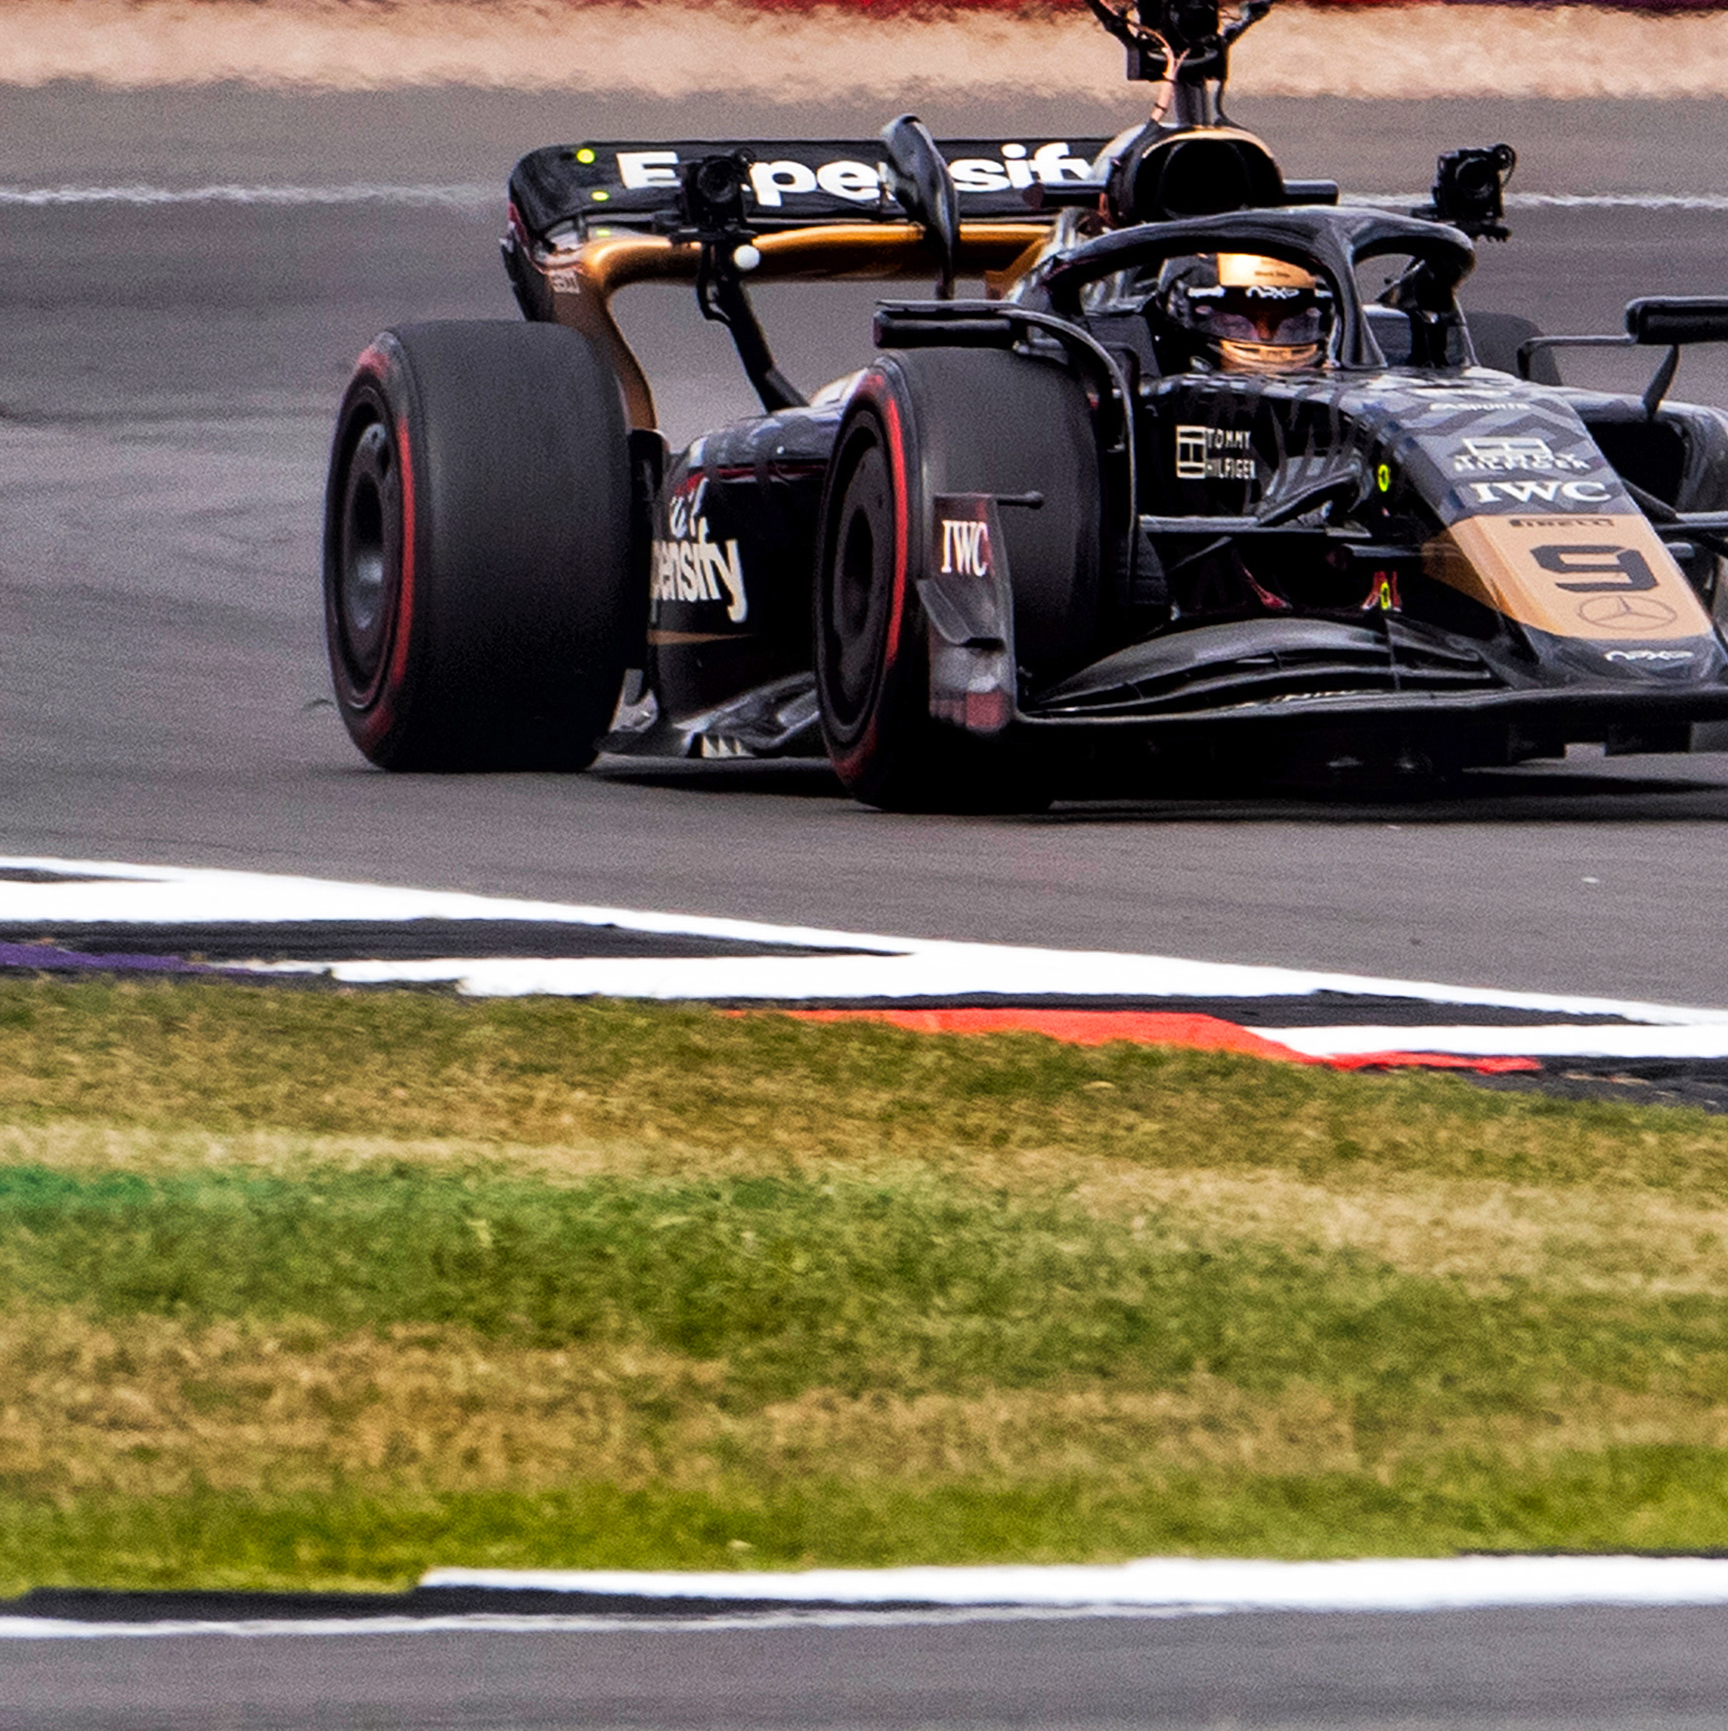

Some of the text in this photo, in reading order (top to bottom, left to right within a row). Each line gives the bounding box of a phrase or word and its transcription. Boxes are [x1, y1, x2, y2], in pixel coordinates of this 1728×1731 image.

[1205, 428, 1251, 449] TOMMY
[1206, 458, 1256, 479] HILFIGER
[1454, 460, 1591, 471] HILFIGER
[1469, 481, 1612, 503] IWC
[941, 521, 990, 576] IWC
[1530, 544, 1660, 593] 9
